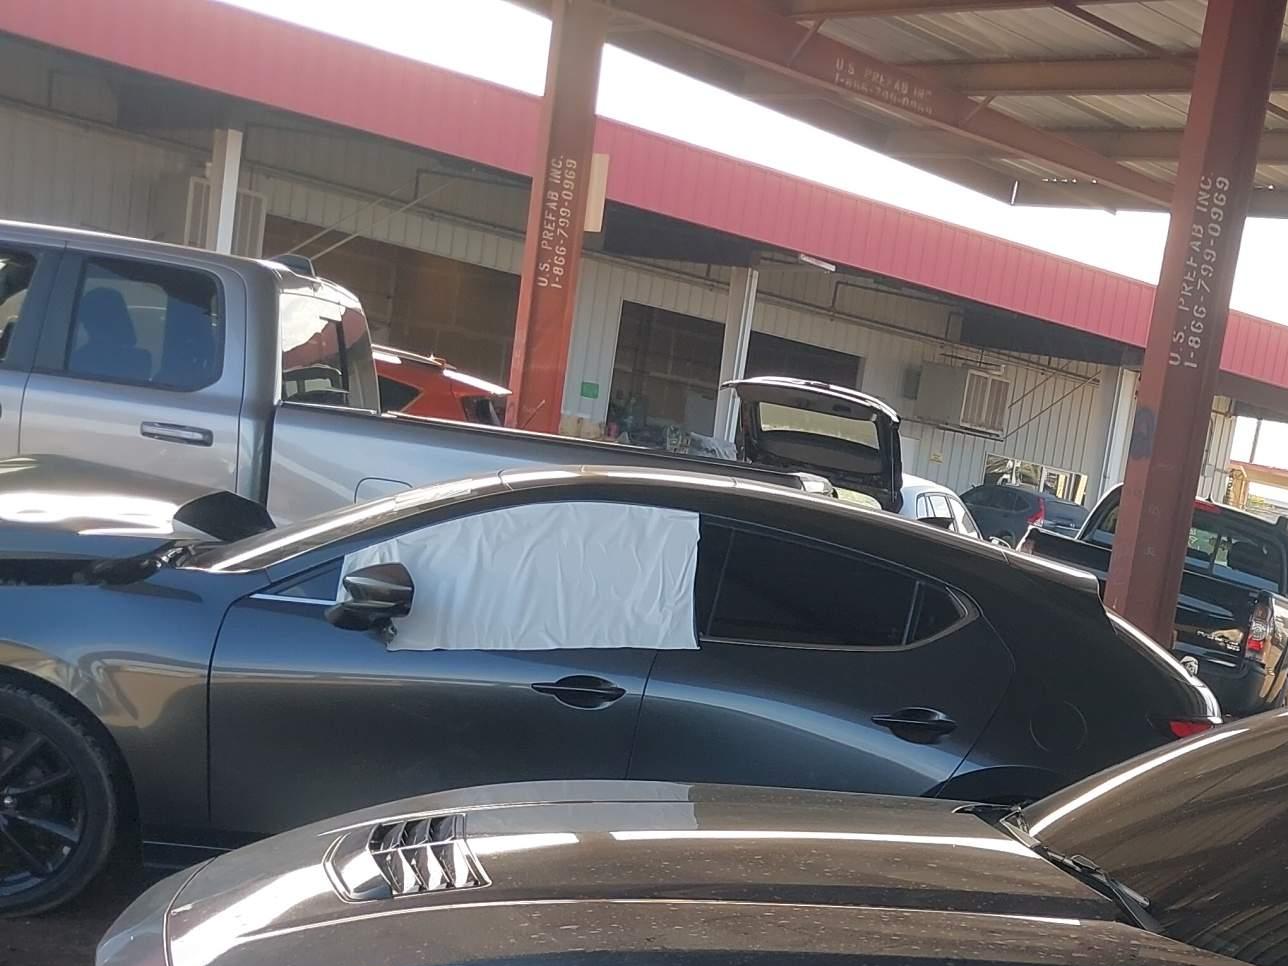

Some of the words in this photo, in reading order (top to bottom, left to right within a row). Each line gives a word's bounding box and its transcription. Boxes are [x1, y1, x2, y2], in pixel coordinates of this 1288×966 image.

[548, 155, 564, 184] INC.
[541, 191, 559, 250] PREFAB
[551, 159, 577, 289] 1-866-799-0969
[537, 259, 552, 287] U.S.
[1169, 325, 1187, 366] U.S.
[1178, 223, 1204, 311] PREFAB
[1184, 176, 1230, 369] 1-866-799-0969
